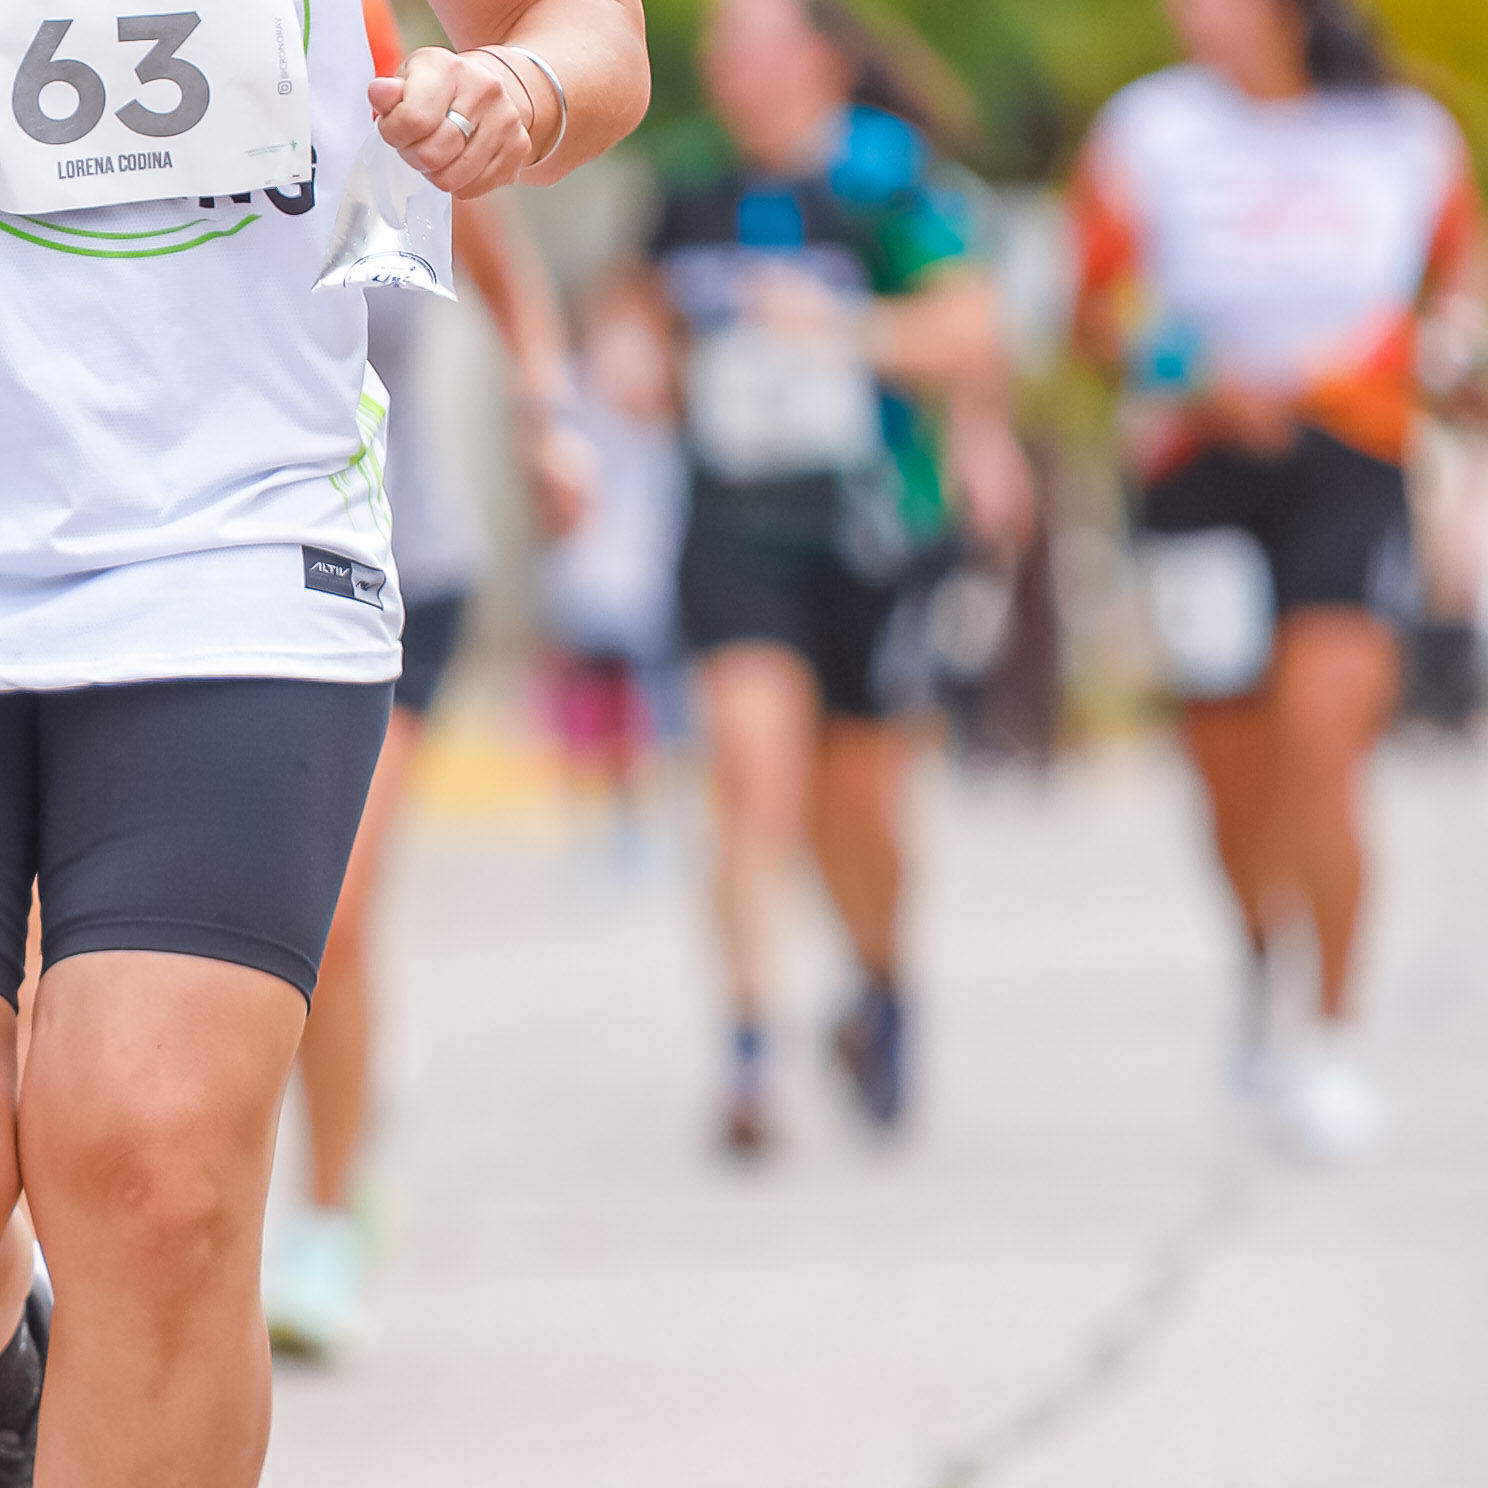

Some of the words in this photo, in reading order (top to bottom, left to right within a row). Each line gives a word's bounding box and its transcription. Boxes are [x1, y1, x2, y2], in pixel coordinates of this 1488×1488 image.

[12, 11, 210, 144] 63
[58, 156, 114, 179] LORENA
[118, 152, 173, 172] CODINA
